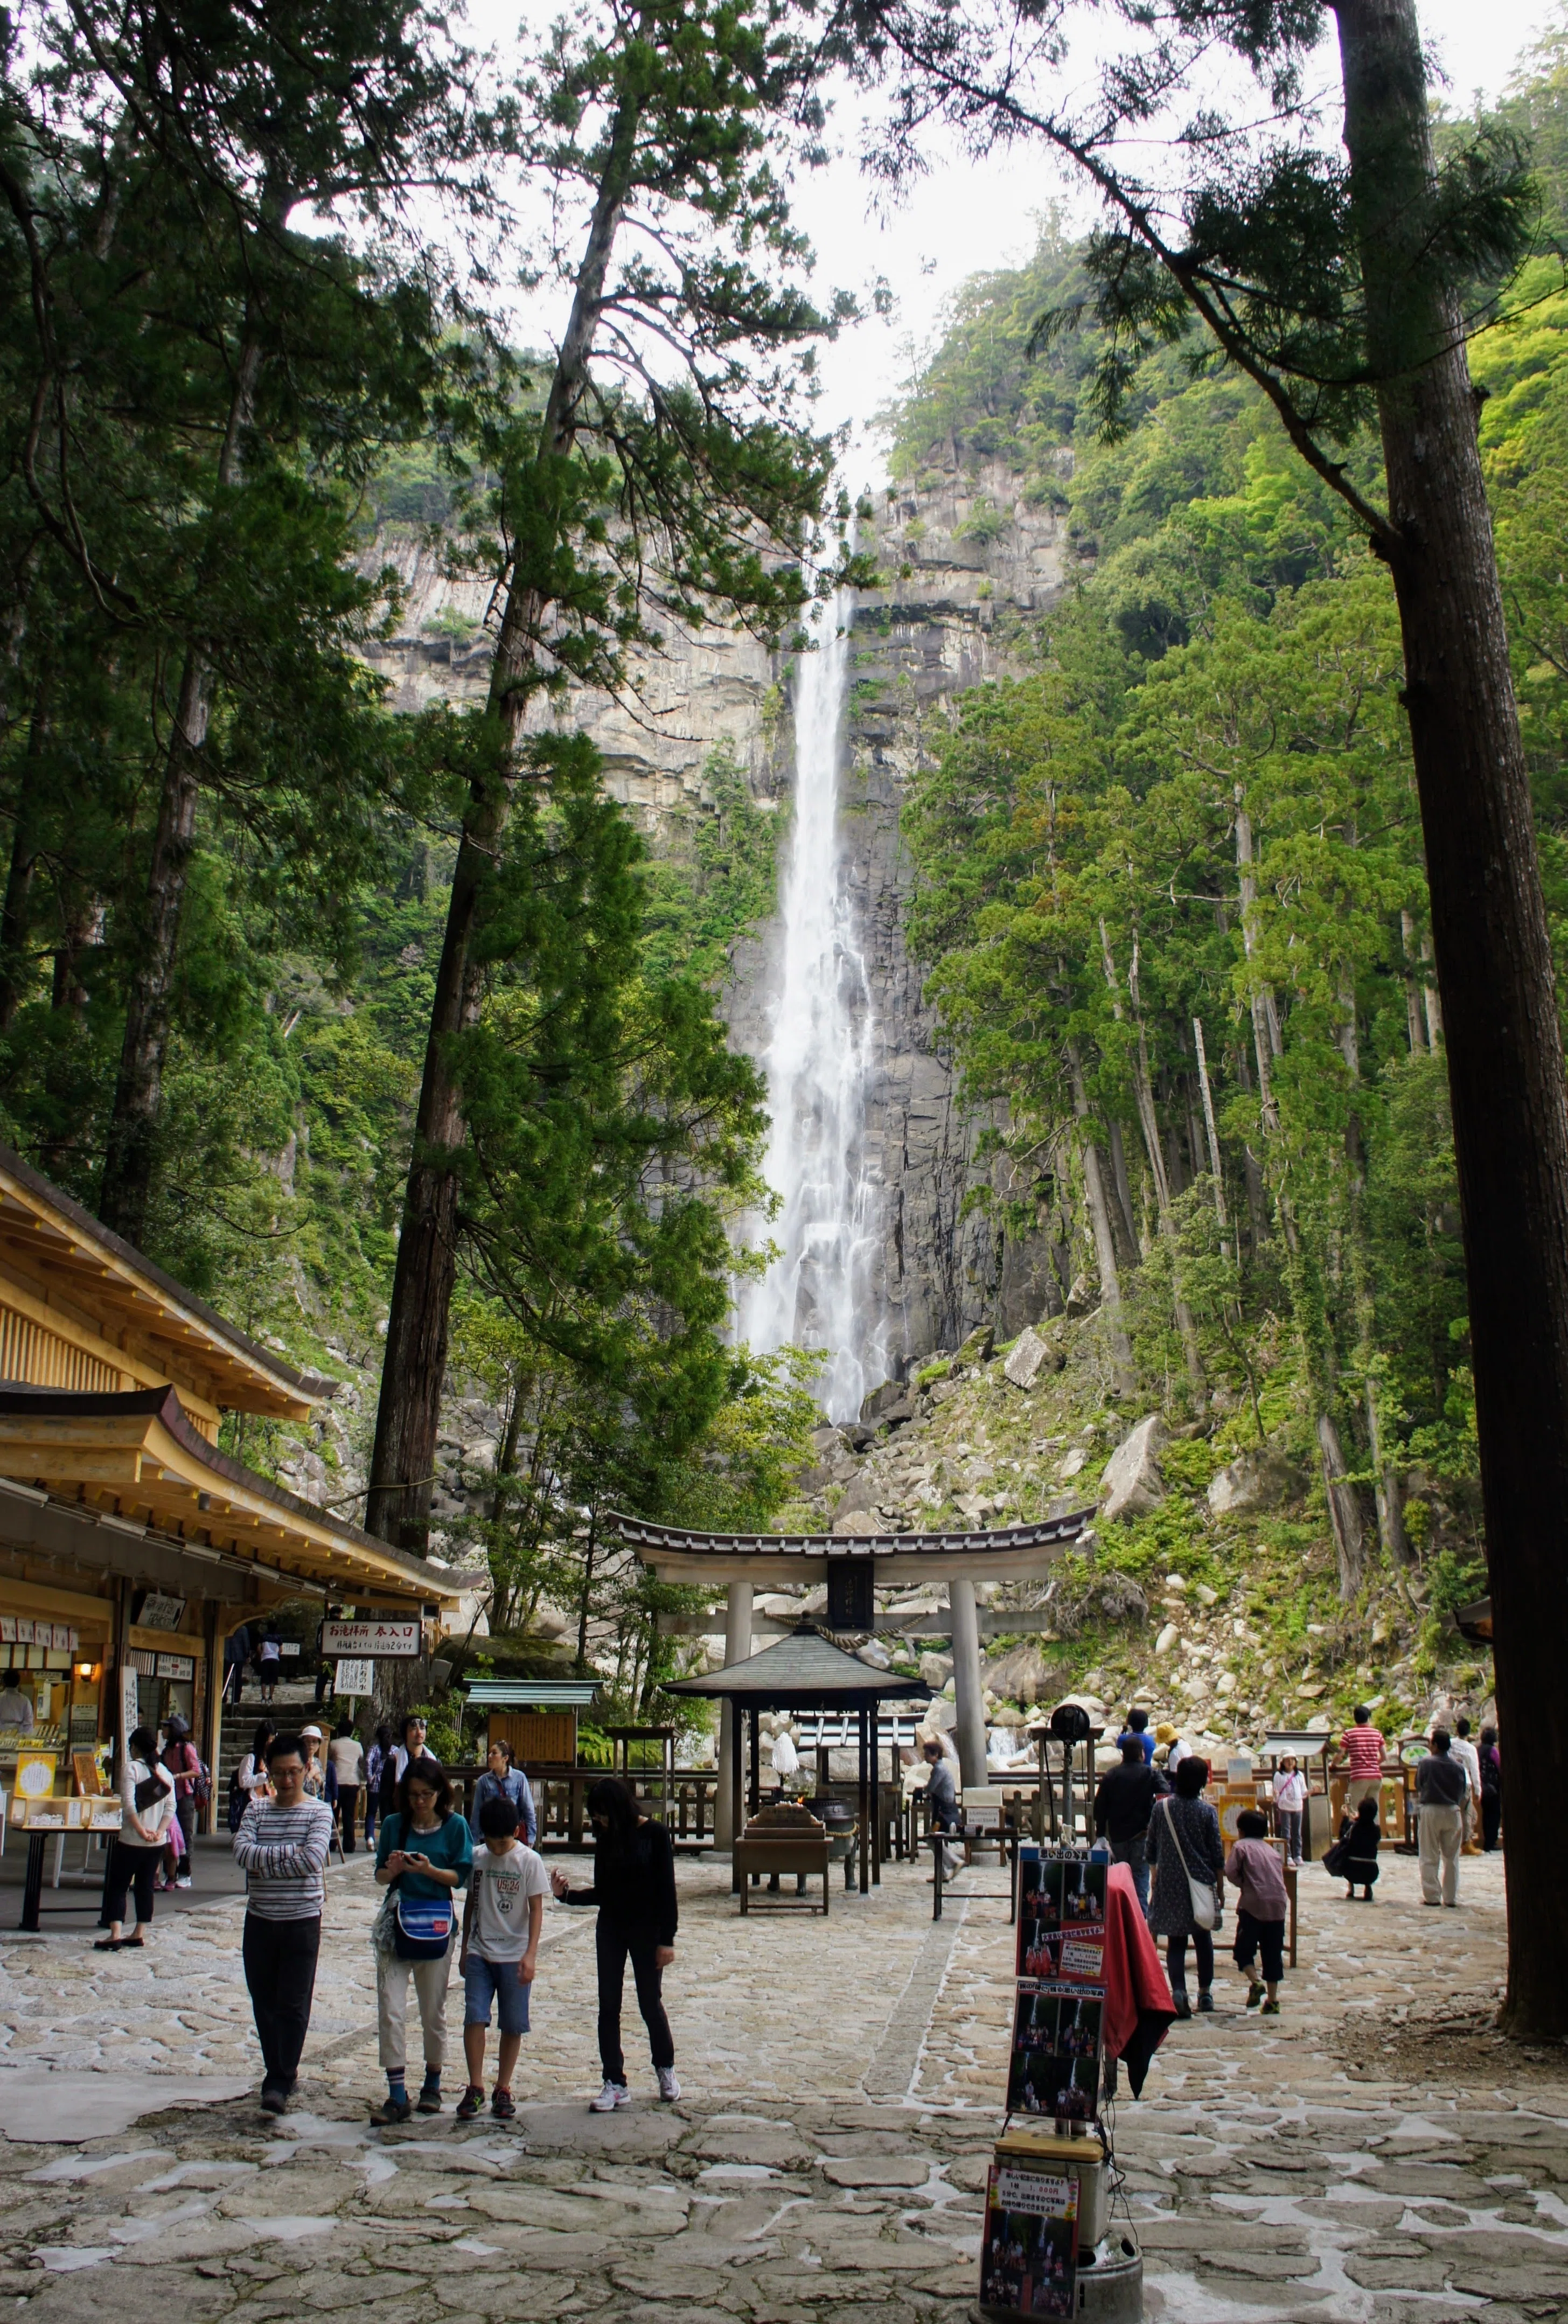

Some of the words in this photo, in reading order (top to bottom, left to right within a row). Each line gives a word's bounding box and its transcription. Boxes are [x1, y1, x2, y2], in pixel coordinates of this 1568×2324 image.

[1040, 1849, 1089, 1861] 思い出の写真
